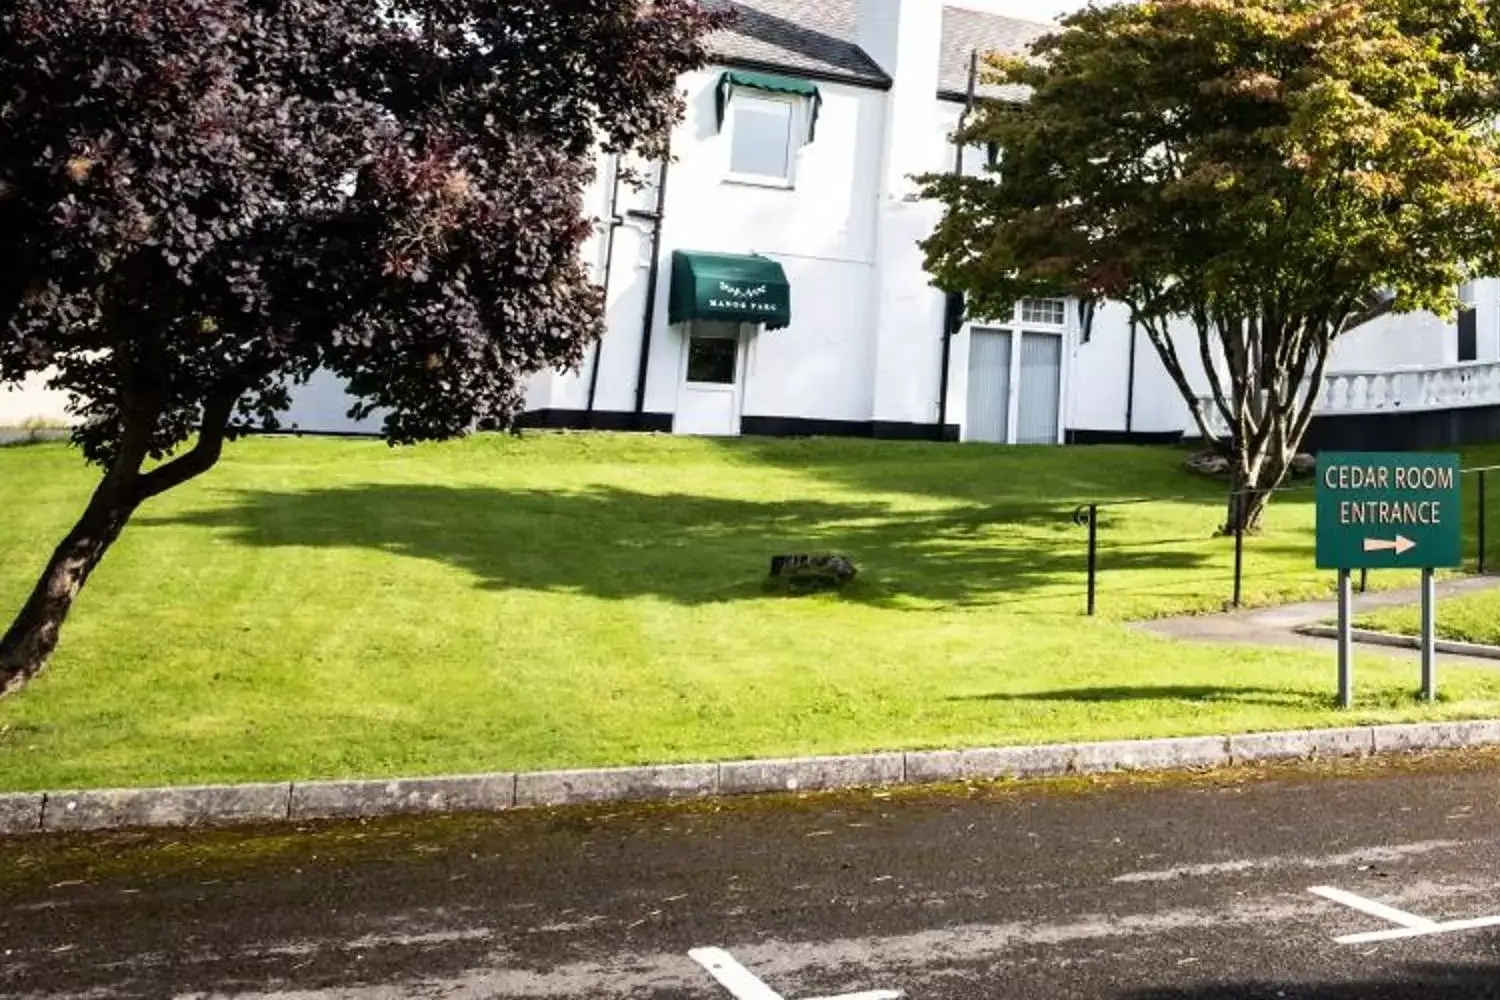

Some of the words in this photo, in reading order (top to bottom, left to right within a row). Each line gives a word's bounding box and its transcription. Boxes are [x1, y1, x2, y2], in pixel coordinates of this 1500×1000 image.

[1325, 466, 1389, 489] CEDAR
[1395, 467, 1453, 489] ROOM
[1340, 501, 1441, 524] ENTRANCE
